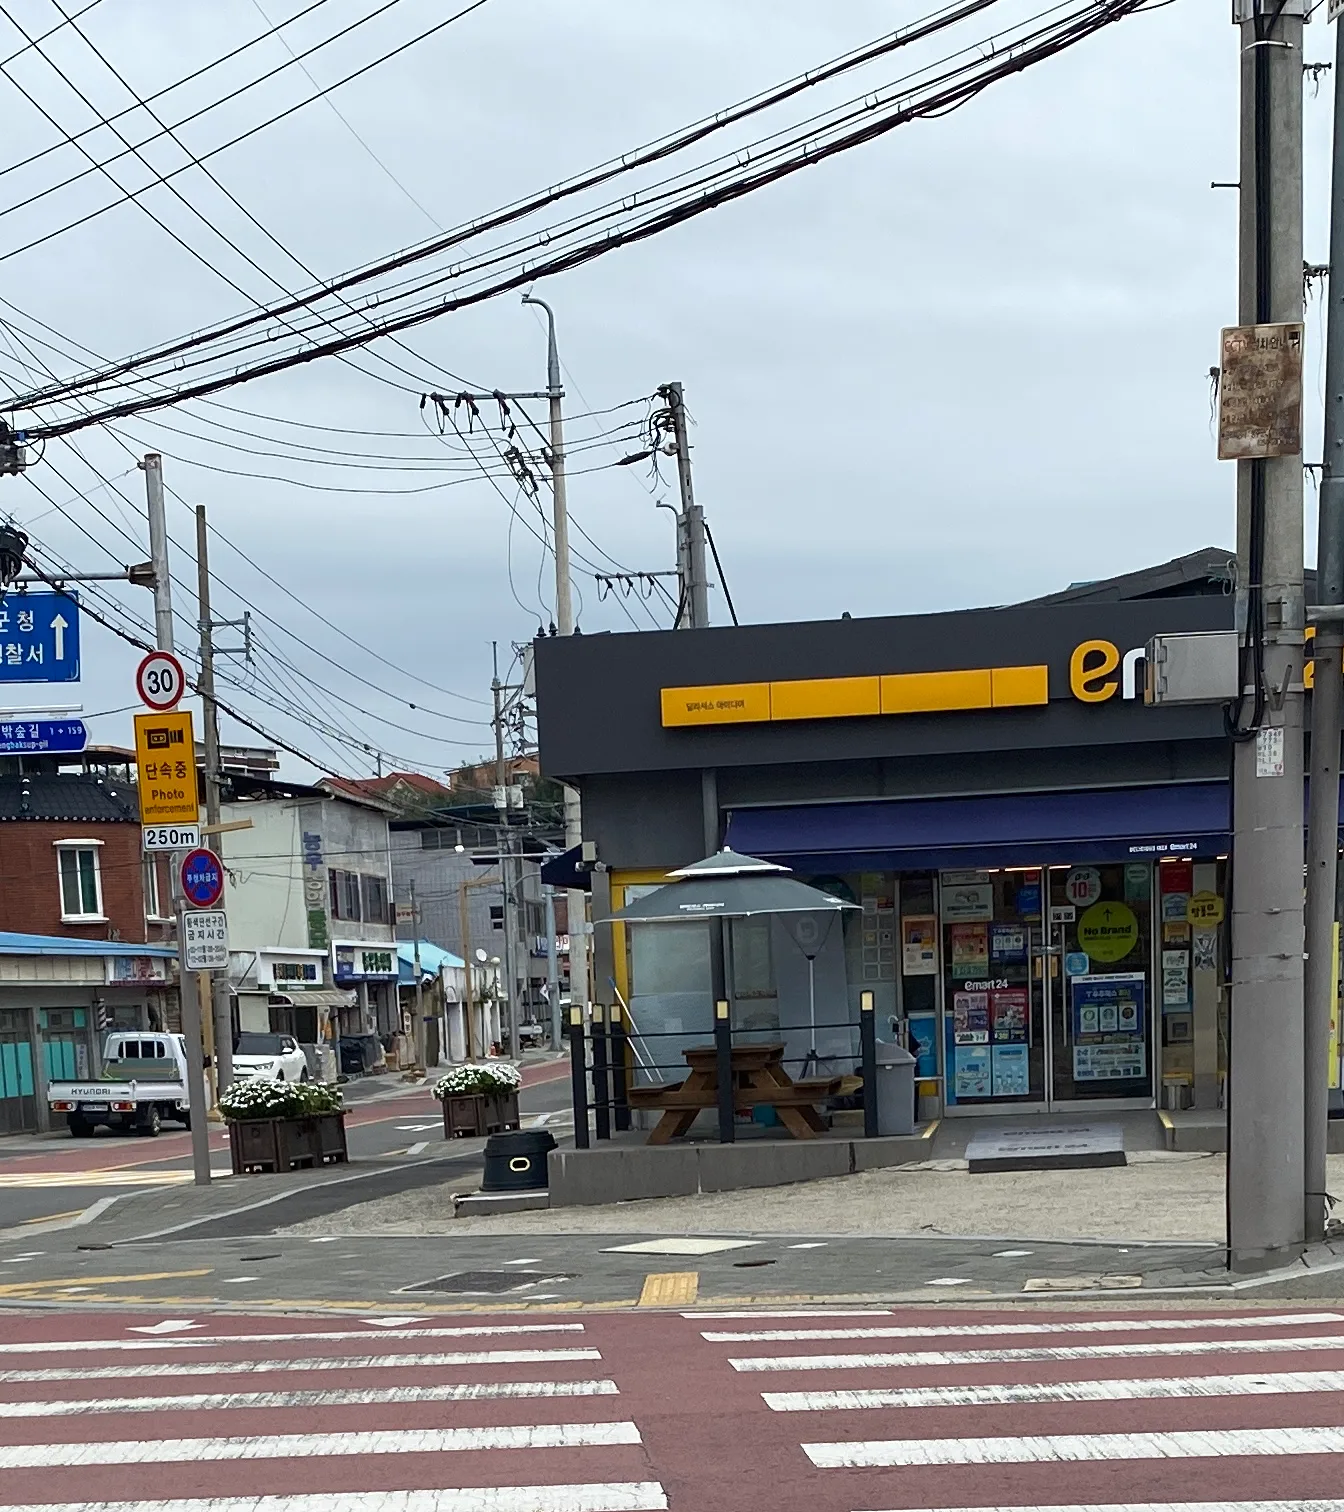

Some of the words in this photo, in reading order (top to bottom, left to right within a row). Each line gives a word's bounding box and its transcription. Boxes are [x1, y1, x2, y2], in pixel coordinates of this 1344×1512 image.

[147, 669, 173, 694] 30
[67, 726, 83, 735] 159
[145, 761, 187, 780] 단속중
[151, 788, 185, 801] Photo
[145, 802, 194, 814] enforcement
[147, 829, 195, 845] 250m
[188, 929, 225, 940] 금지시간
